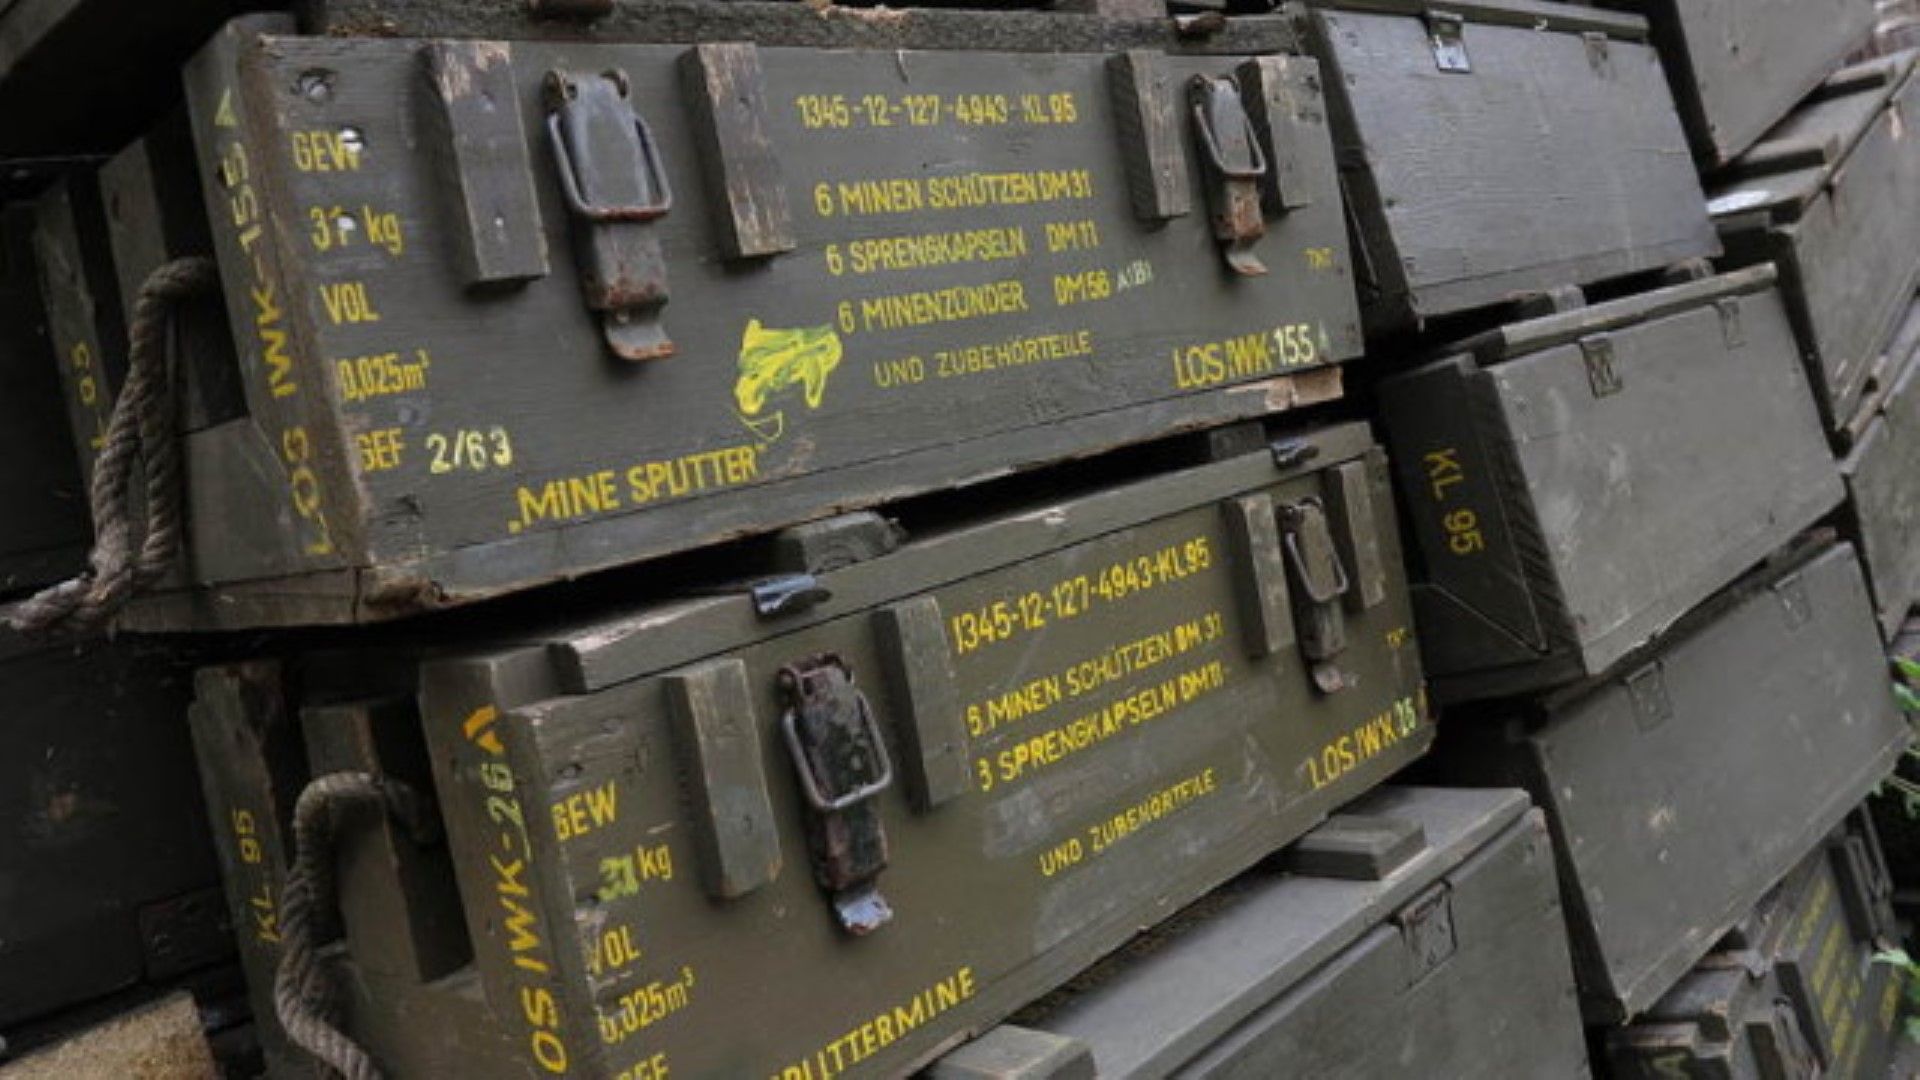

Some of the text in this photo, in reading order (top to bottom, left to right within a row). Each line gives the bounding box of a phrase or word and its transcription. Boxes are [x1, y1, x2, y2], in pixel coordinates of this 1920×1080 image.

[813, 182, 834, 217] 6
[837, 178, 922, 216] MINEN
[362, 204, 403, 255] kg
[825, 244, 844, 276] 6
[320, 282, 381, 325] VOL
[838, 300, 856, 334] 6
[874, 356, 924, 388] UND
[1173, 342, 1225, 388] LOS
[425, 425, 513, 474] 2/63
[279, 424, 334, 555] LOS
[1423, 448, 1485, 554] KL 95
[986, 674, 1061, 729] MINEN
[977, 757, 993, 793] 3
[998, 680, 1176, 782] SPRENGKAPSELN
[1306, 734, 1356, 789] LOS
[551, 779, 617, 841] GEW
[232, 808, 262, 864] 95
[1039, 838, 1084, 877] UND
[637, 844, 673, 882] kg
